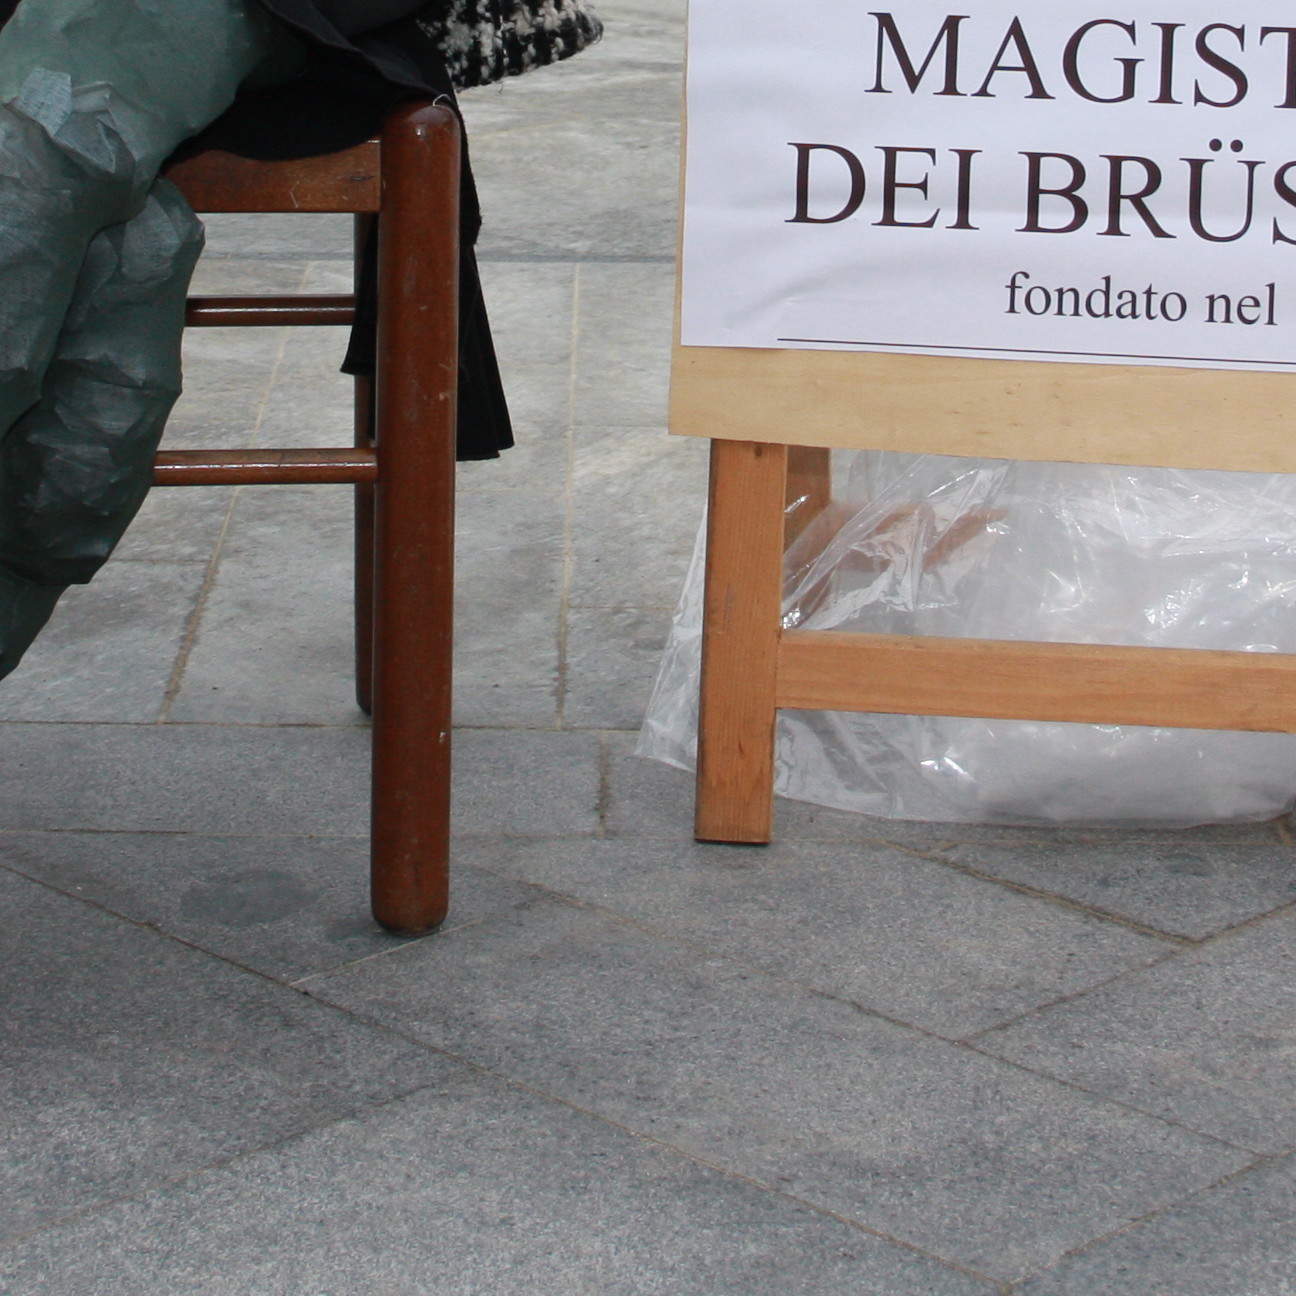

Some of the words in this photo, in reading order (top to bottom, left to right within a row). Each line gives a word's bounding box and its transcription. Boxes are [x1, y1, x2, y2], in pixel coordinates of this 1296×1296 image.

[784, 142, 983, 231] DEI
[1004, 270, 1188, 322] fondato
[1204, 282, 1278, 326] nel
